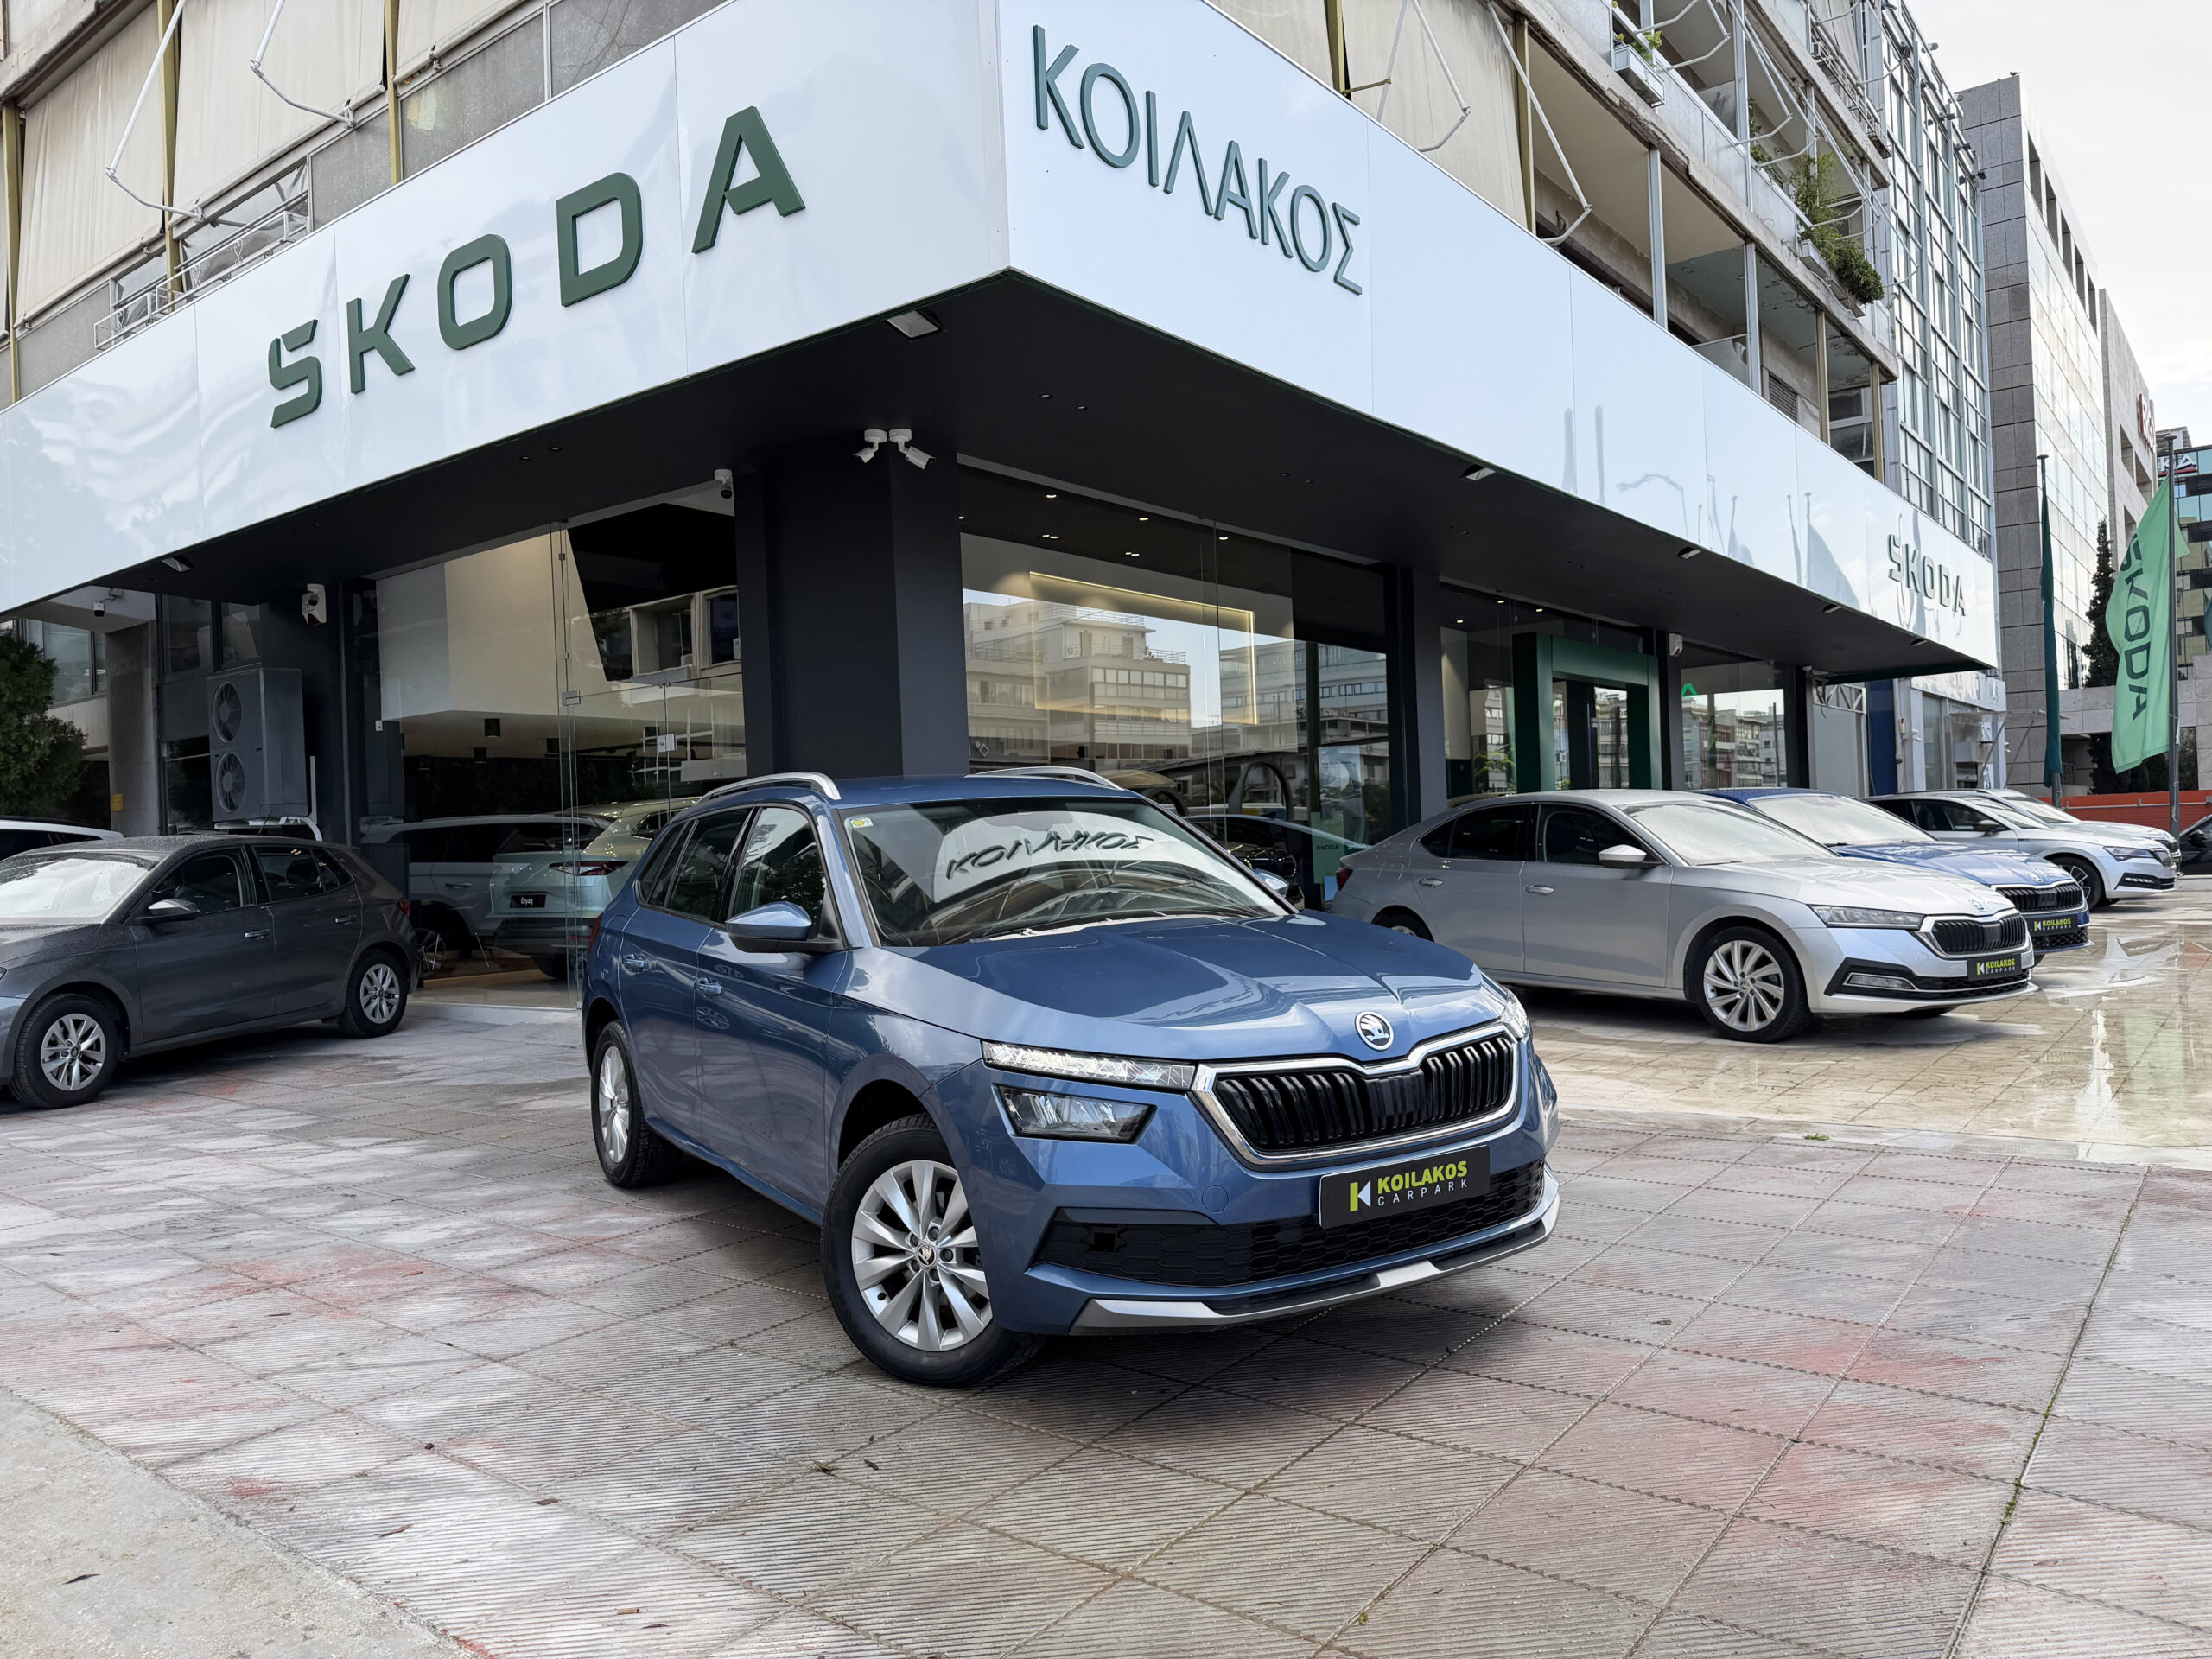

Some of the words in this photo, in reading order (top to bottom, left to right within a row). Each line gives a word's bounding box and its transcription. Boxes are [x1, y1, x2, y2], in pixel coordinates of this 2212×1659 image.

[1033, 24, 1362, 295] ΚΟΙΛΑΚΟΣ
[269, 105, 806, 428] SKODA
[1887, 533, 1966, 616] SKODA
[2042, 918, 2072, 927] KOILAKOS
[1986, 958, 2016, 969] KOILAKOS
[1377, 1160, 1468, 1194] KOILAKOS
[1377, 1179, 1467, 1206] CARPARK
